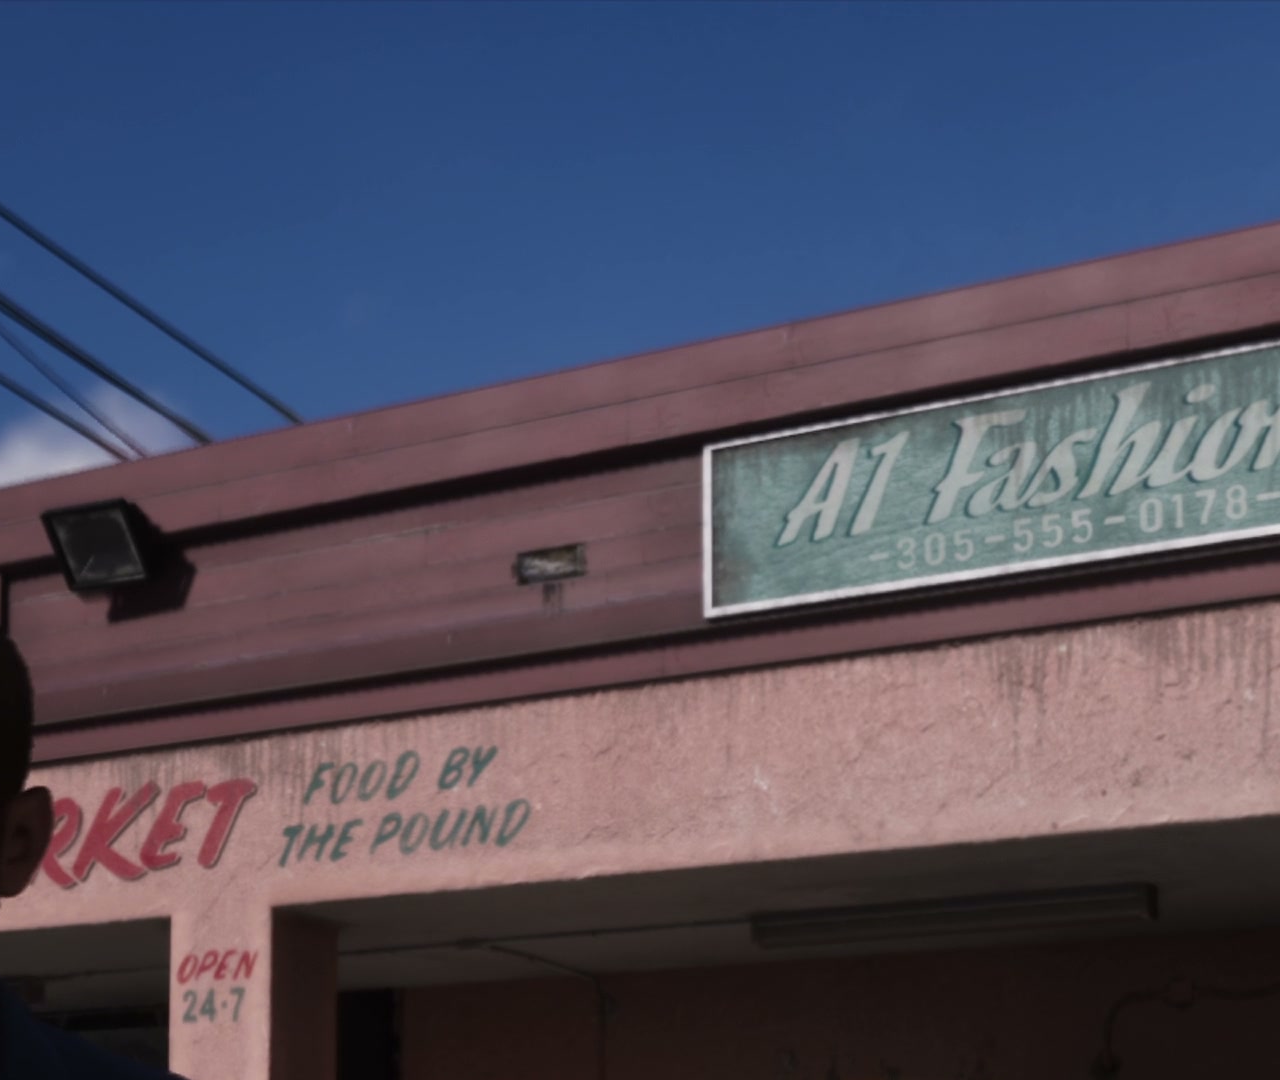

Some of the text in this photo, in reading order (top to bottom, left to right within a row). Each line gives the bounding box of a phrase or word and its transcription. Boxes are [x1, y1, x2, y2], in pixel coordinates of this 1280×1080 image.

[775, 429, 910, 547] A1
[305, 745, 498, 804] FOOD BY
[41, 779, 257, 888] RKET
[279, 800, 531, 866] THE POUND
[177, 949, 258, 984] OPEN
